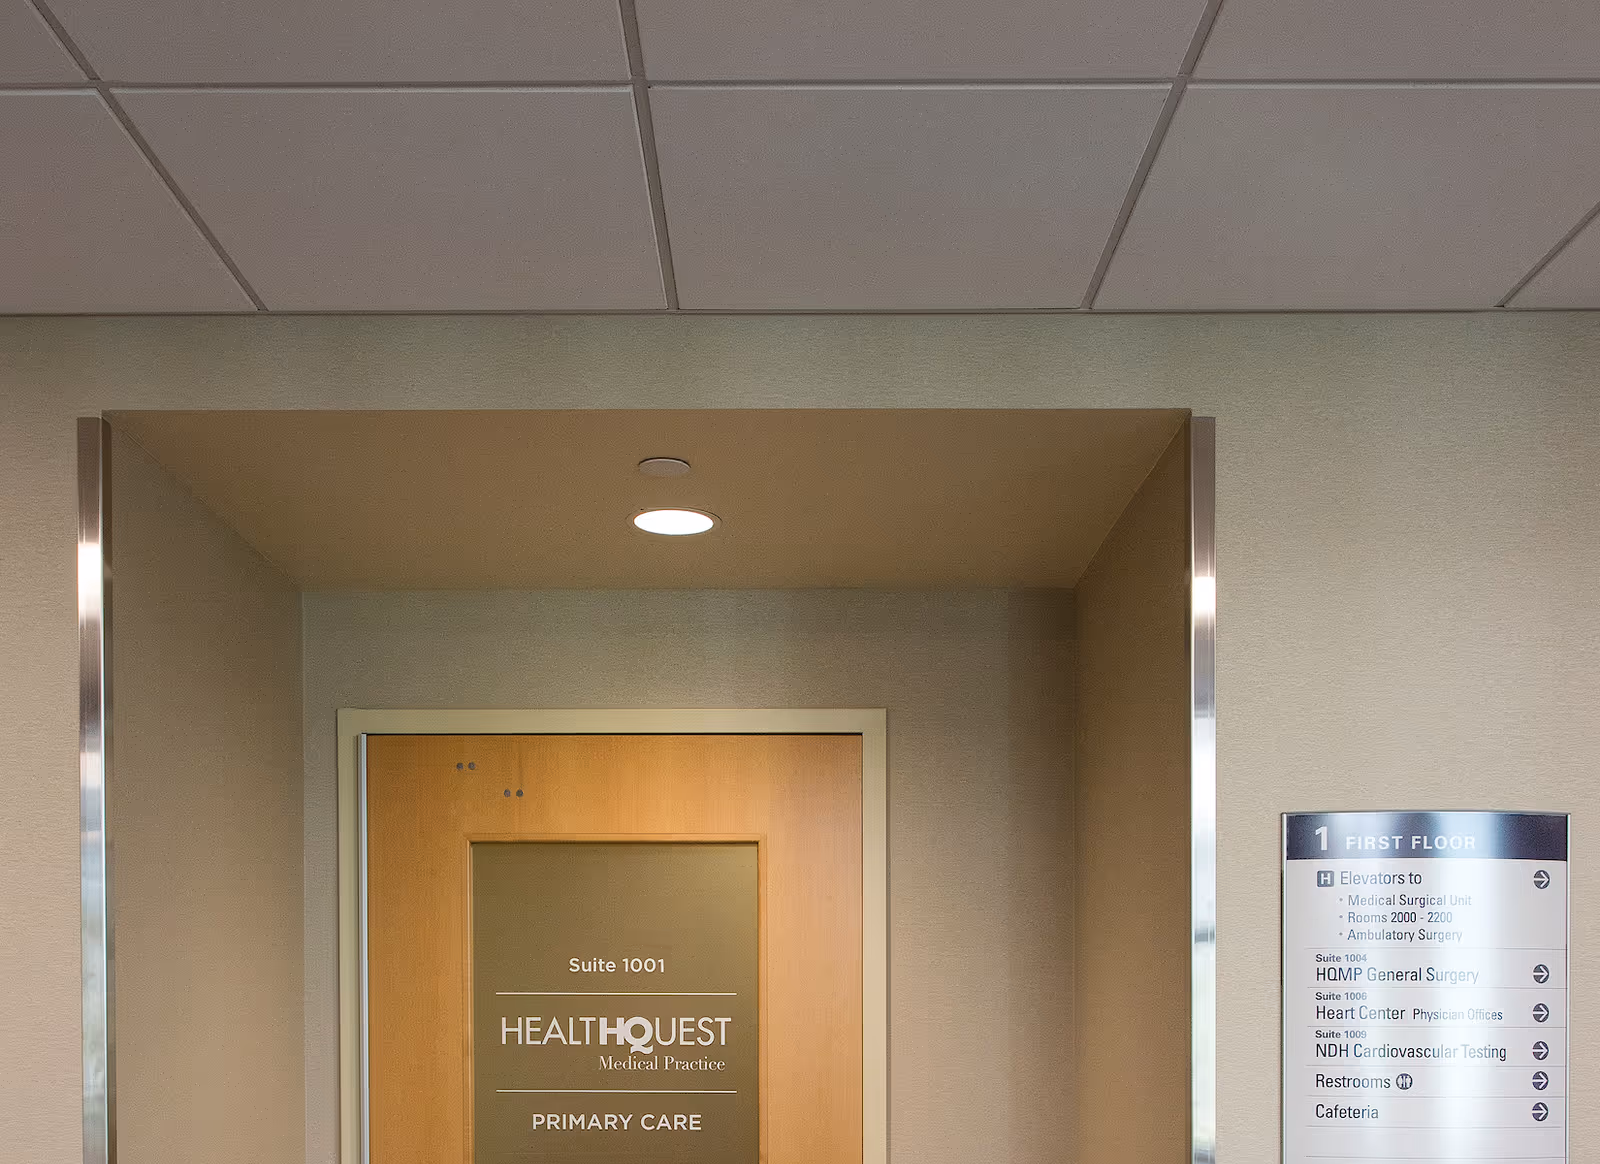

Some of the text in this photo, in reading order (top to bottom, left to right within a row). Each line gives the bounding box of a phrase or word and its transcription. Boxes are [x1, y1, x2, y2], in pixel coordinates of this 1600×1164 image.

[1315, 826, 1476, 850] 1 FIRST FLOOR
[1340, 871, 1405, 885] Elevators
[1408, 872, 1422, 885] to
[1348, 894, 1472, 909] Medical Surgical Unit
[1348, 912, 1388, 923] Rooms
[1390, 912, 1417, 923] 2000
[1427, 912, 1453, 923] 2200
[1347, 929, 1463, 942] Ambulatory Surgery
[569, 958, 665, 973] Suite 1001
[1315, 954, 1367, 963] Suite 1004
[1316, 967, 1479, 985] HQMP General Surgery
[1315, 992, 1367, 1001] Suite 1006
[1316, 1005, 1503, 1023] Heart Center Physician Offices
[501, 1016, 732, 1054] HEALTHQUEST
[1315, 1030, 1367, 1039] Suite 1009
[1316, 1043, 1507, 1062] NDH Cardiovascular Testing
[599, 1056, 726, 1071] Medical Practice
[1316, 1074, 1391, 1089] Restrooms
[1316, 1104, 1379, 1119] Cafeteria
[532, 1113, 702, 1131] PRIMARY CARE
